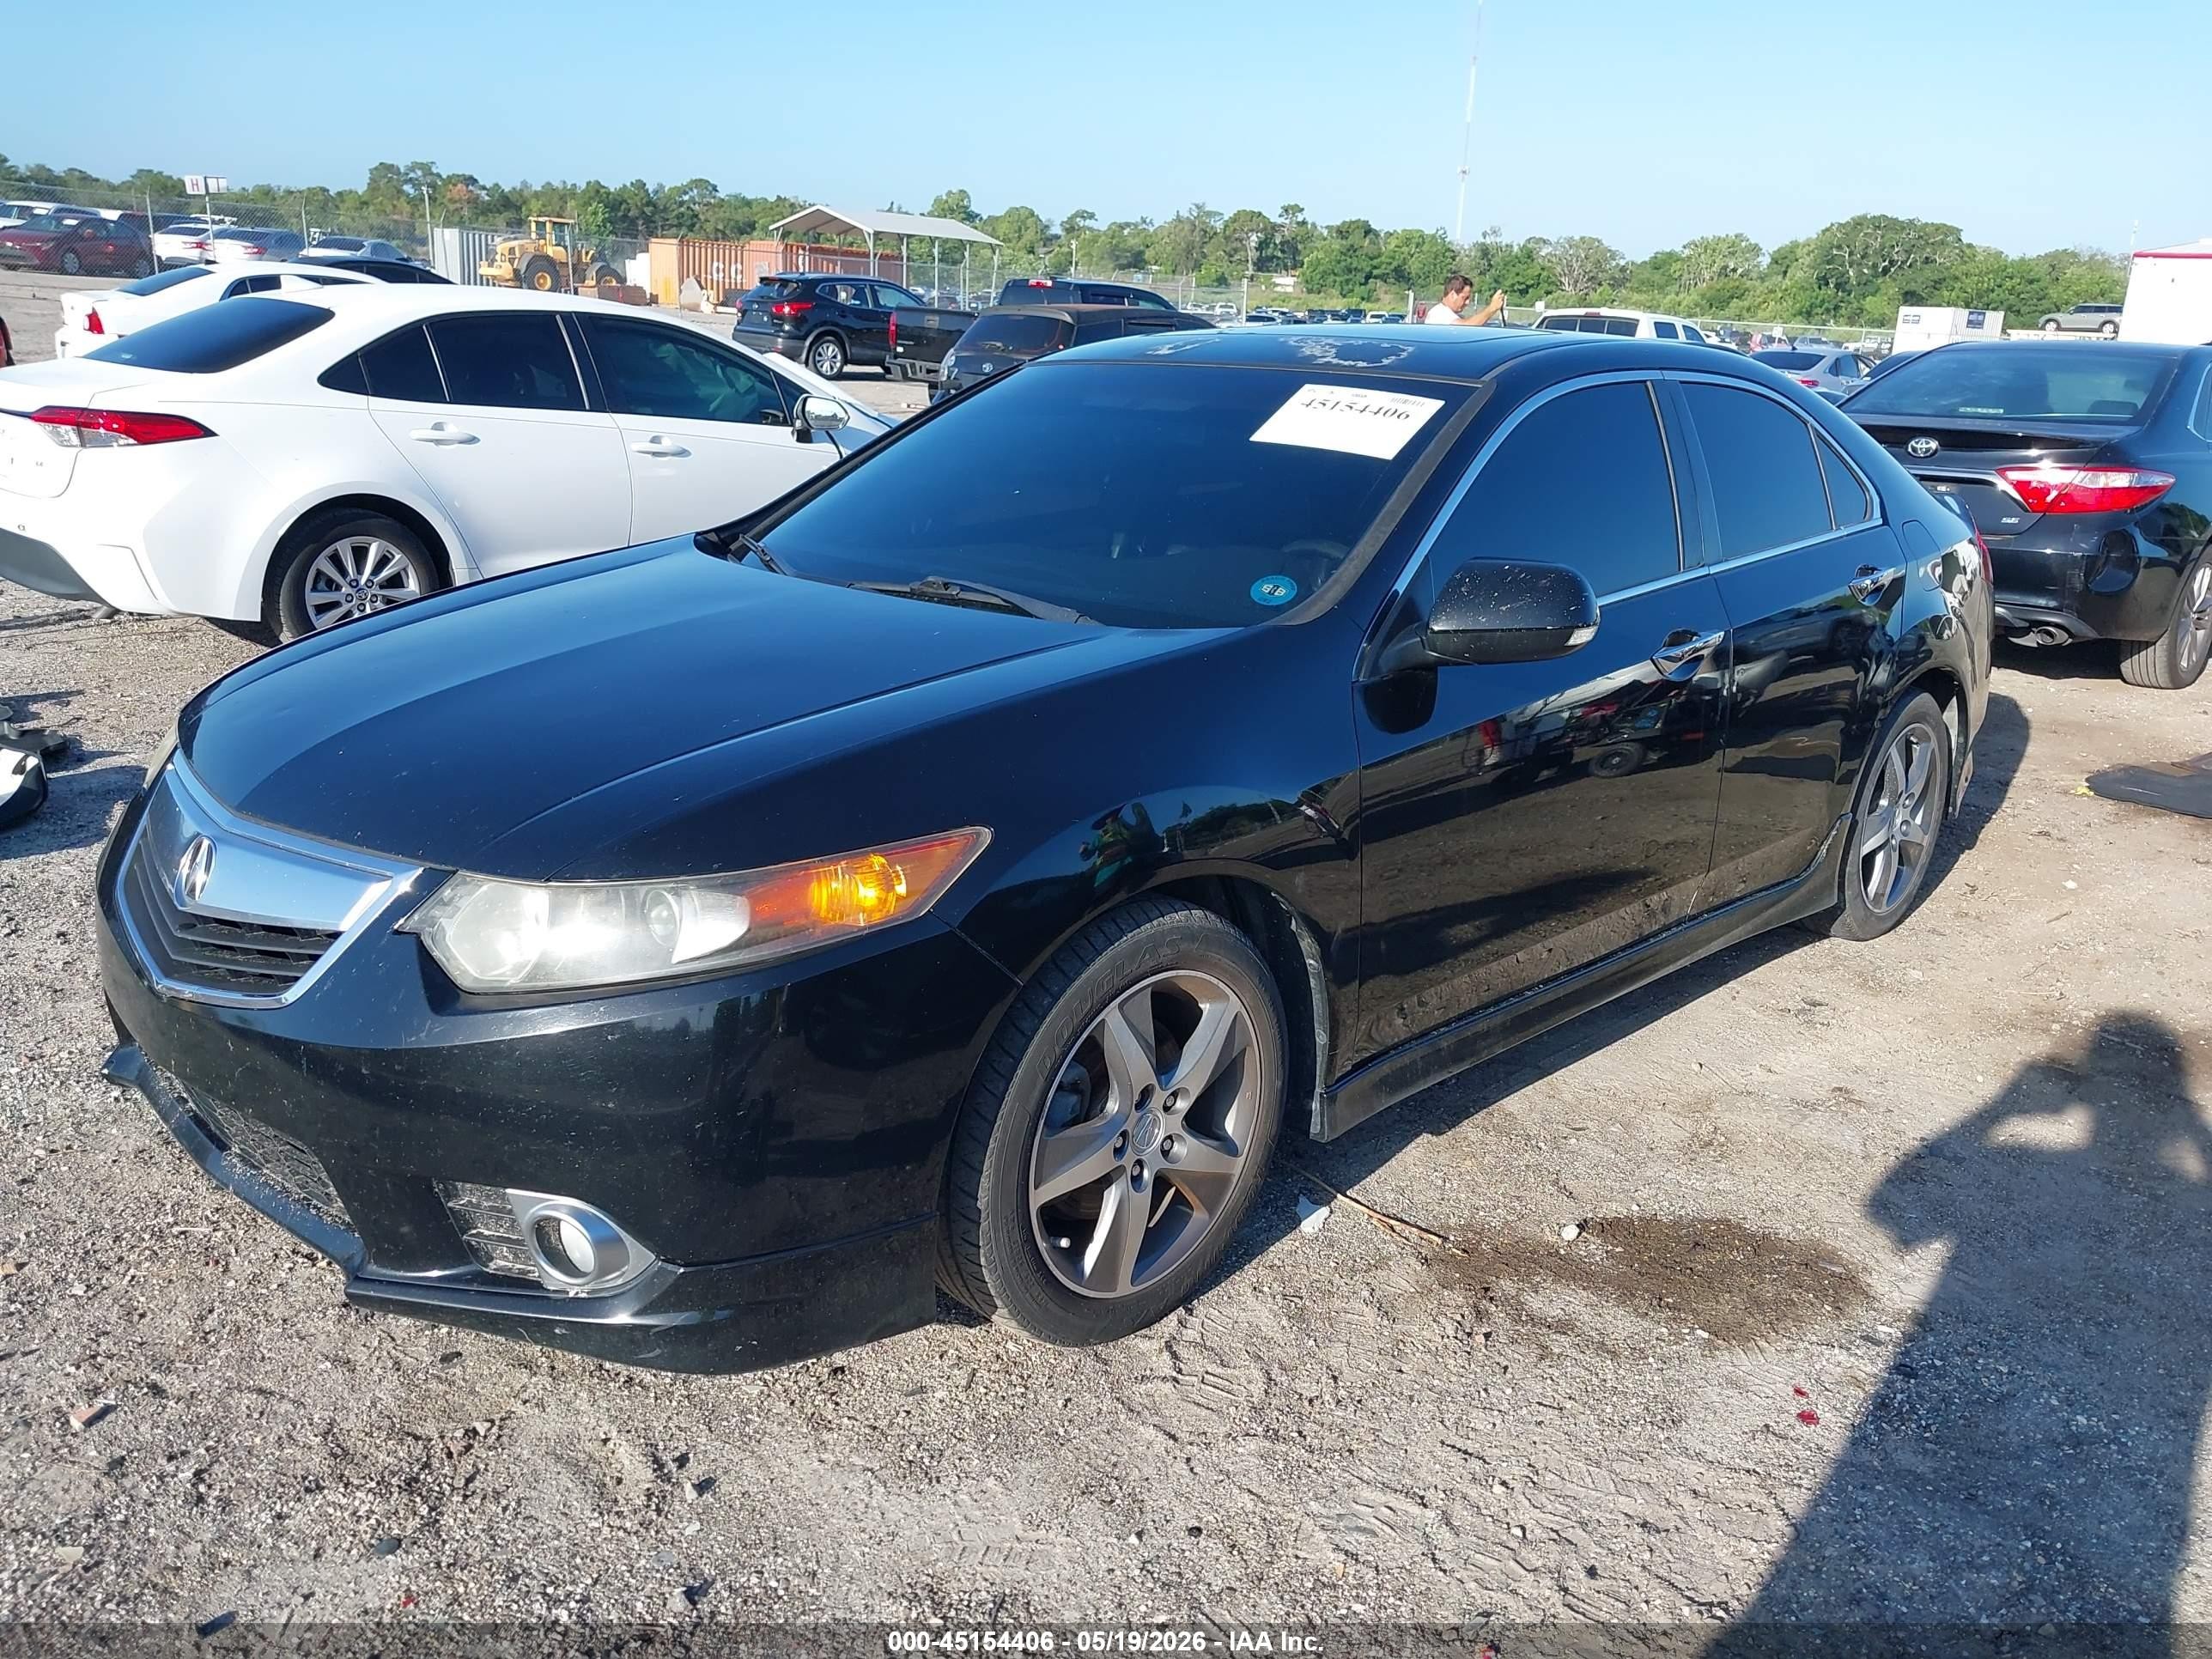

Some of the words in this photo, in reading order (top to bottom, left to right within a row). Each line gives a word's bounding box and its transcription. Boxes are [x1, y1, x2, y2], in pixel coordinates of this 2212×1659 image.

[191, 178, 199, 191] H
[1301, 398, 1410, 420] 45154406
[1036, 936, 1182, 1081] DOUGLAS
